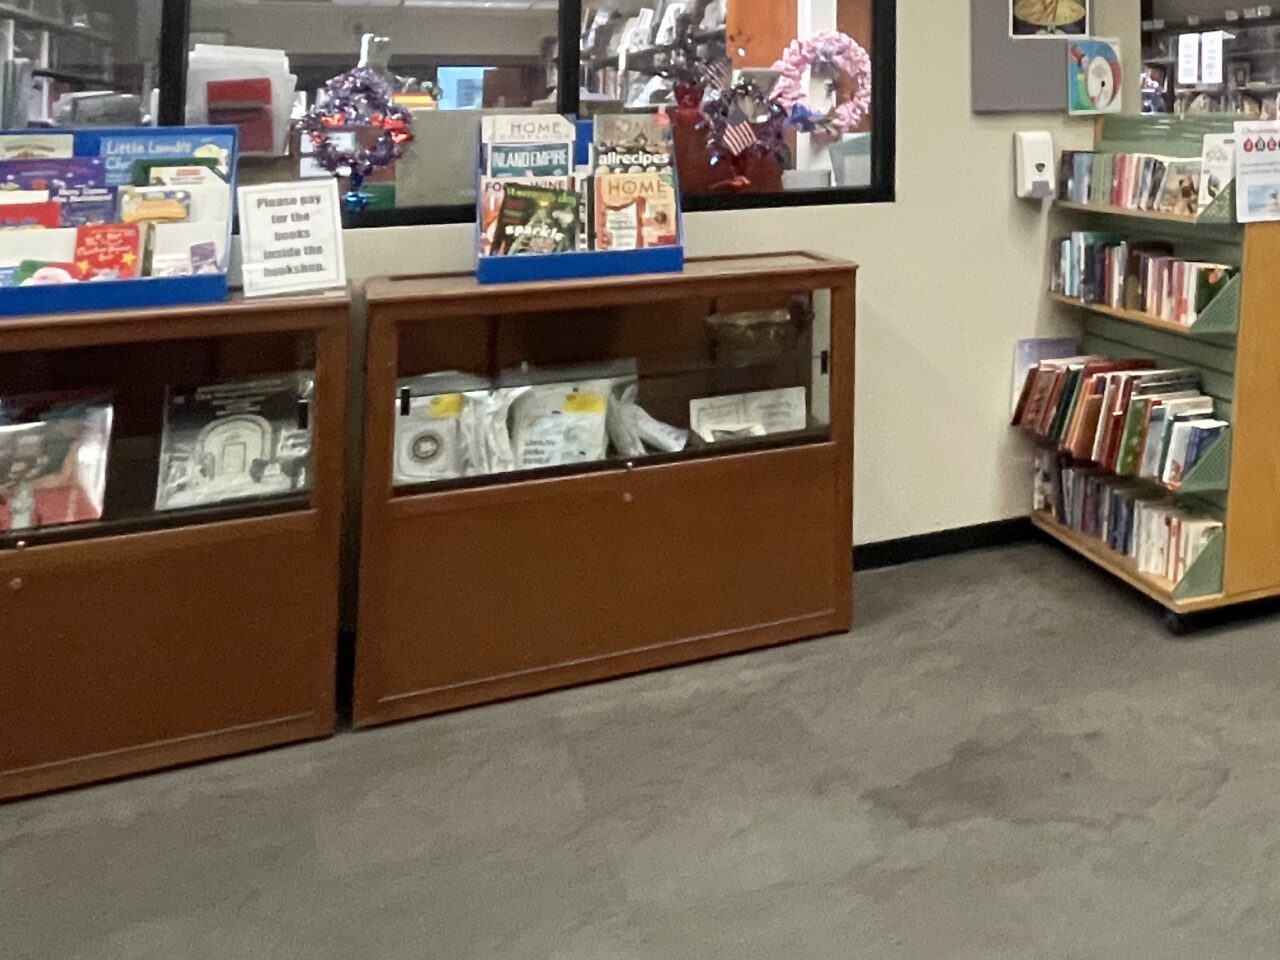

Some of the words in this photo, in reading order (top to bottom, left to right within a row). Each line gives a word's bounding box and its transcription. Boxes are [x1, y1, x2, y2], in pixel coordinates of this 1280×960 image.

[511, 122, 562, 134] HOME
[530, 148, 567, 167] EMPIRE
[598, 151, 670, 166] allrecipes
[485, 181, 502, 193] FO
[608, 180, 667, 195] HOME
[257, 197, 297, 208] Please
